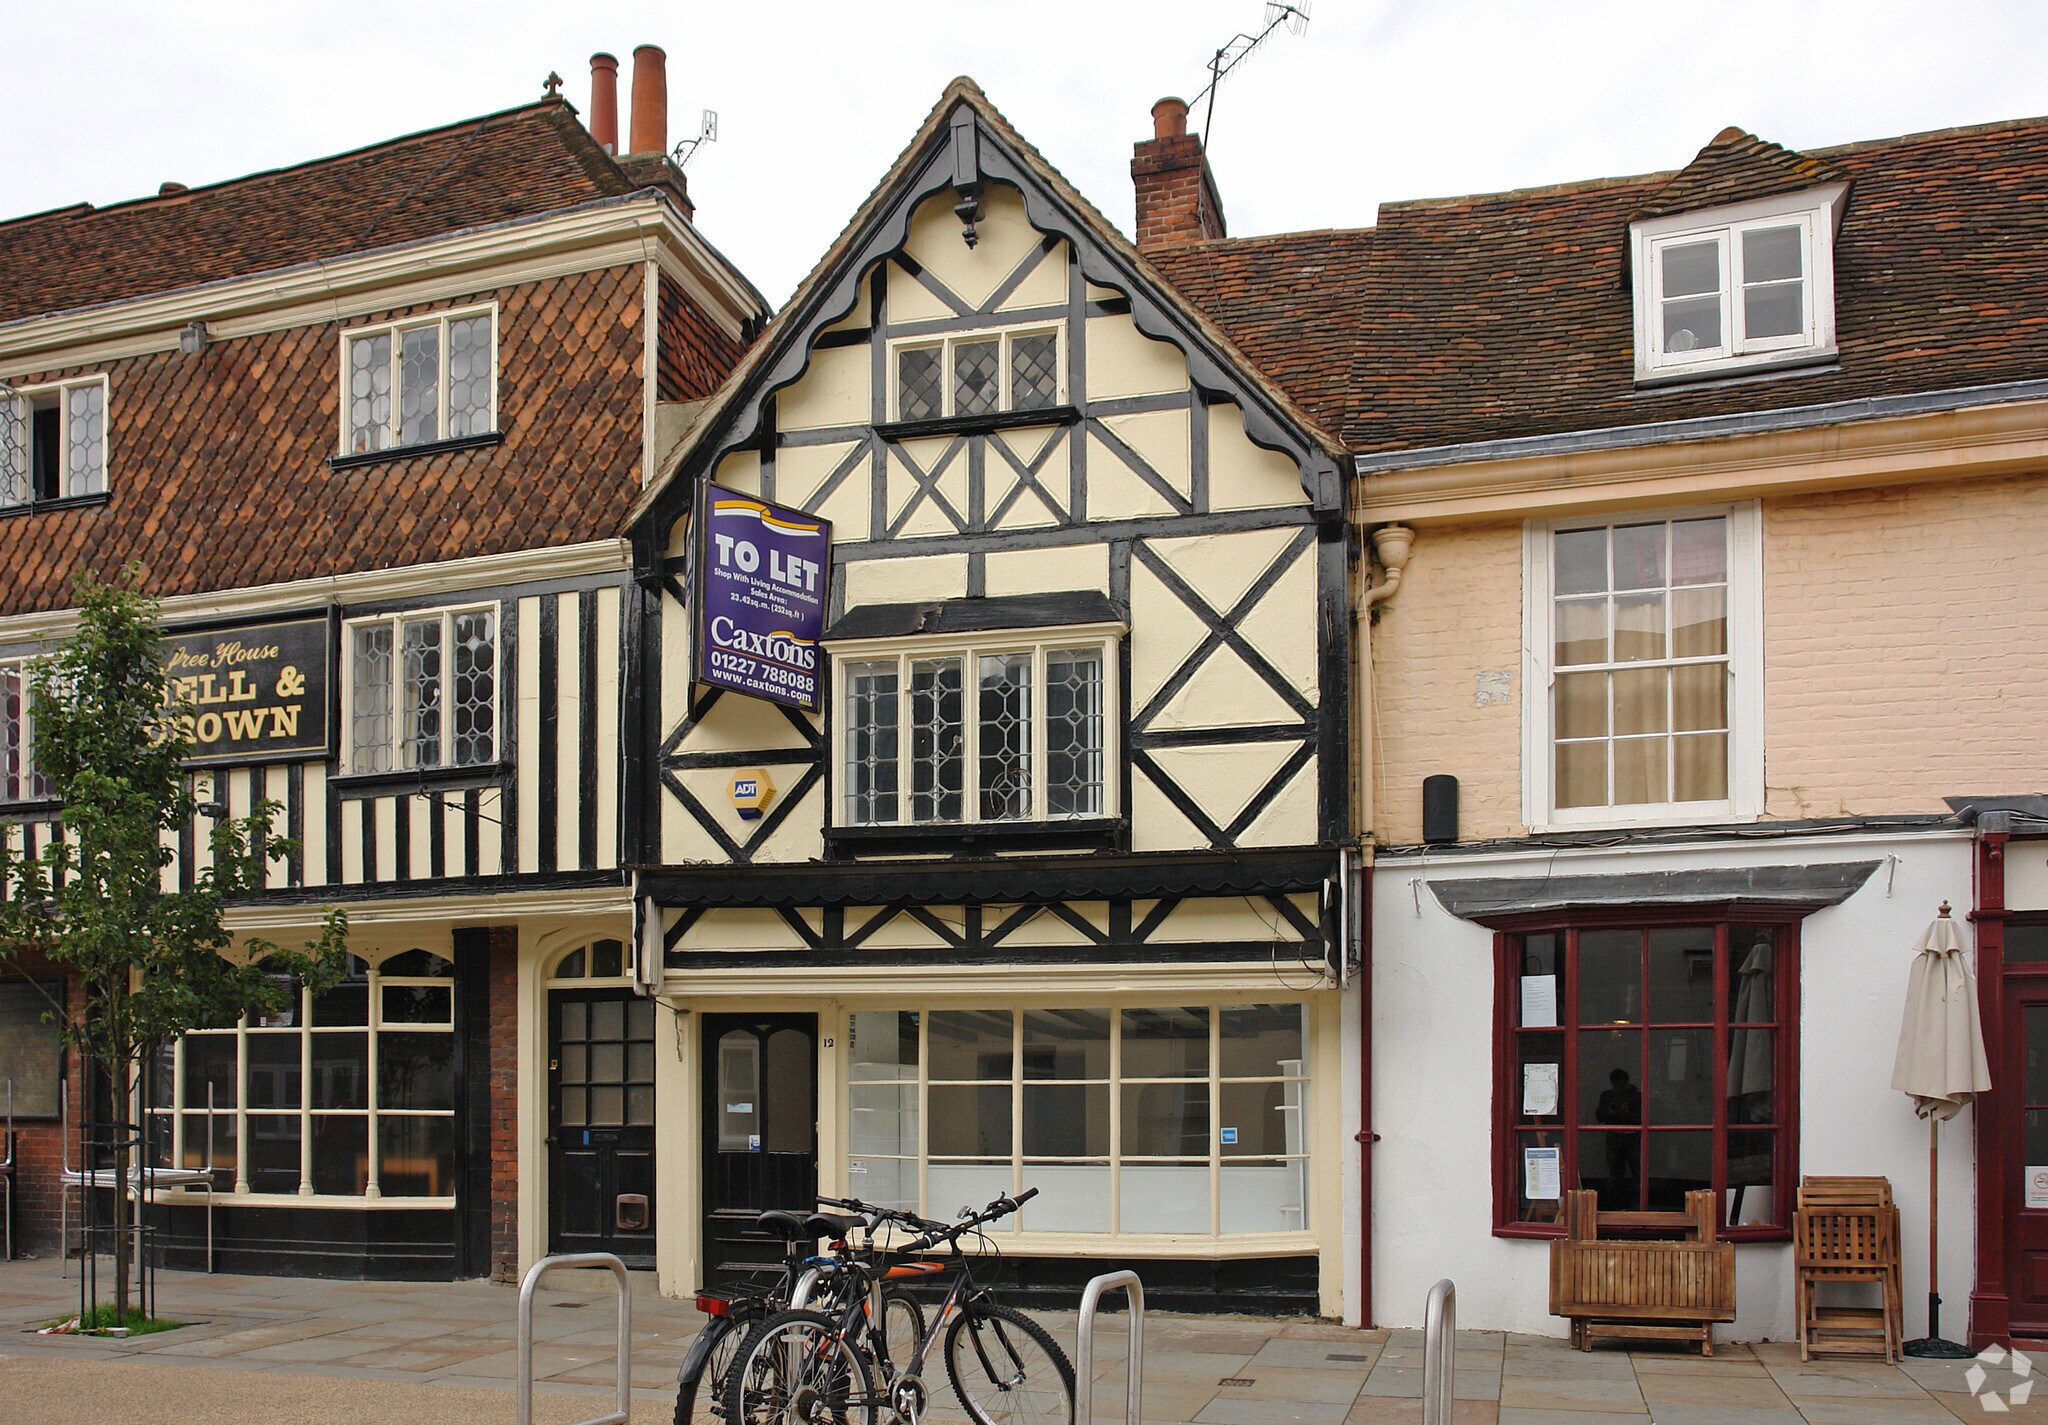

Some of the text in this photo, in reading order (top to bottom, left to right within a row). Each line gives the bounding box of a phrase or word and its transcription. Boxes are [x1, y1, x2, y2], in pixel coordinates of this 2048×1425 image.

[715, 533, 819, 592] TO LET
[714, 568, 819, 605] Shop With Living Accommodation
[730, 592, 770, 611] 23.42sq.m.
[750, 587, 788, 605] Sales Area:
[210, 641, 279, 668] House
[711, 616, 815, 670] Caxtons
[275, 665, 305, 697] &
[711, 651, 815, 692] 01227 788088
[712, 668, 812, 702] www.caxtons.com
[735, 784, 757, 795] ADT
[824, 1038, 834, 1048] 12
